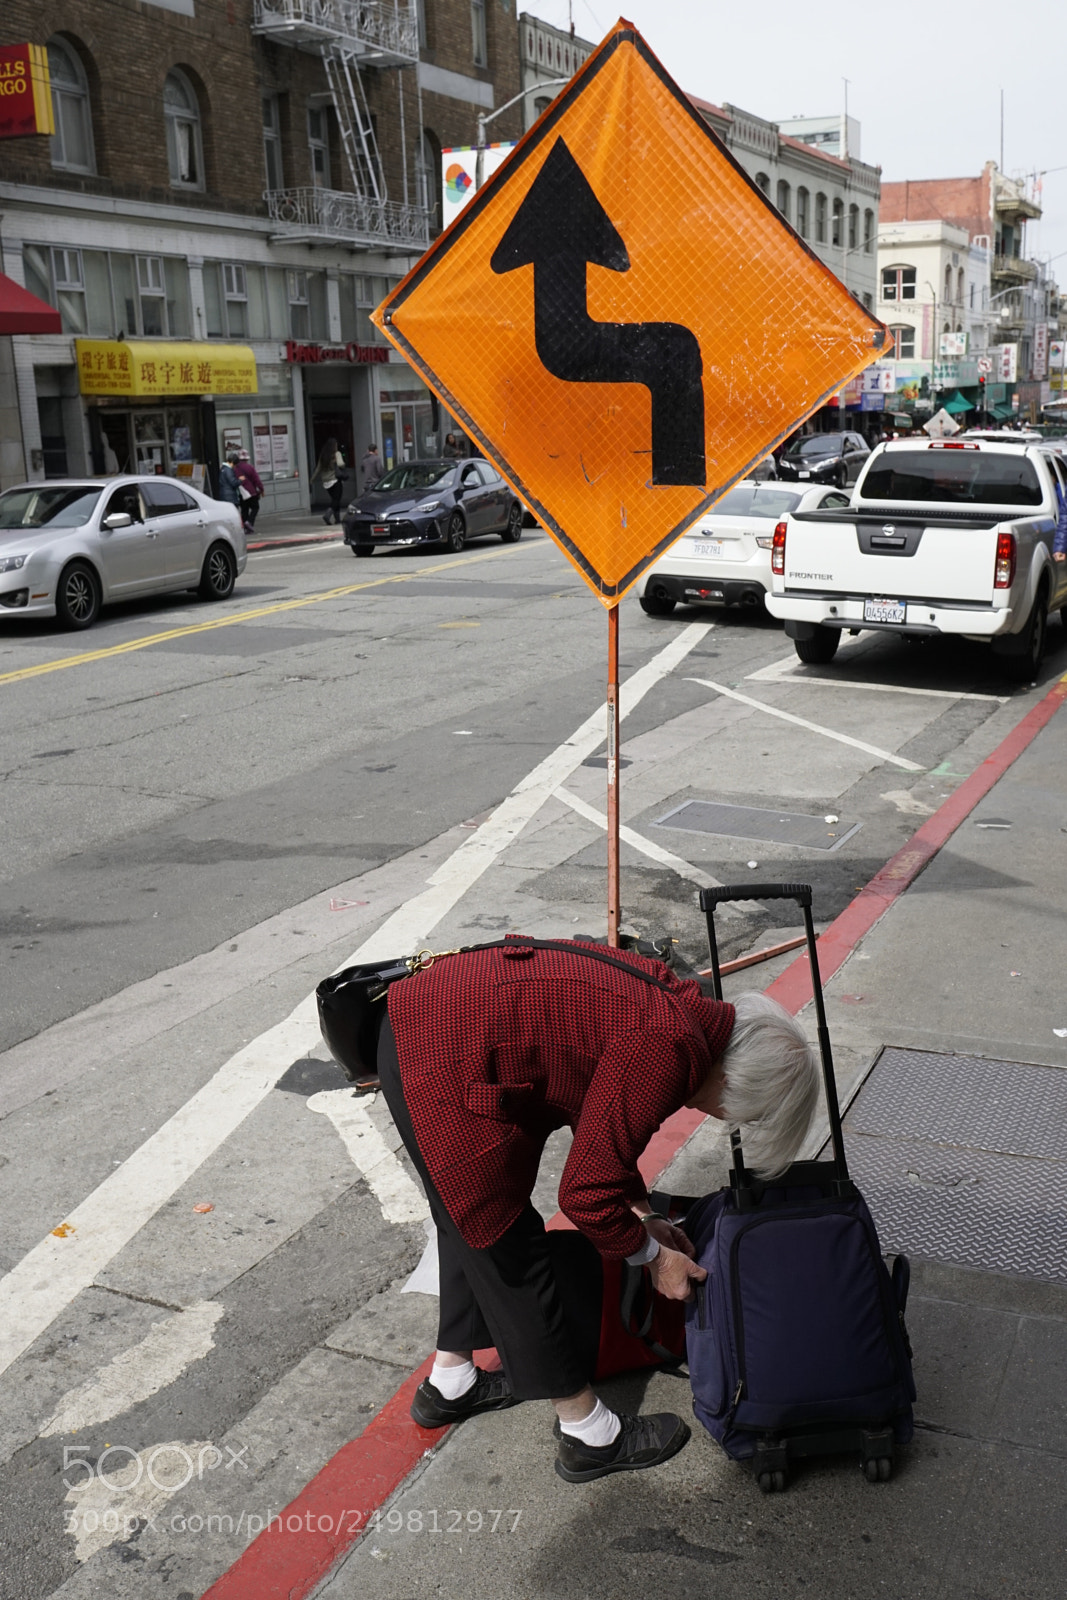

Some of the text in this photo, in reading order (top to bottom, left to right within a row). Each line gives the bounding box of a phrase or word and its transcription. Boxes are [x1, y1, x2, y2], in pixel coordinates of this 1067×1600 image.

[141, 361, 212, 385] 環宇旅遊
[789, 572, 833, 580] FRONTIER
[866, 607, 904, 620] 04556K2
